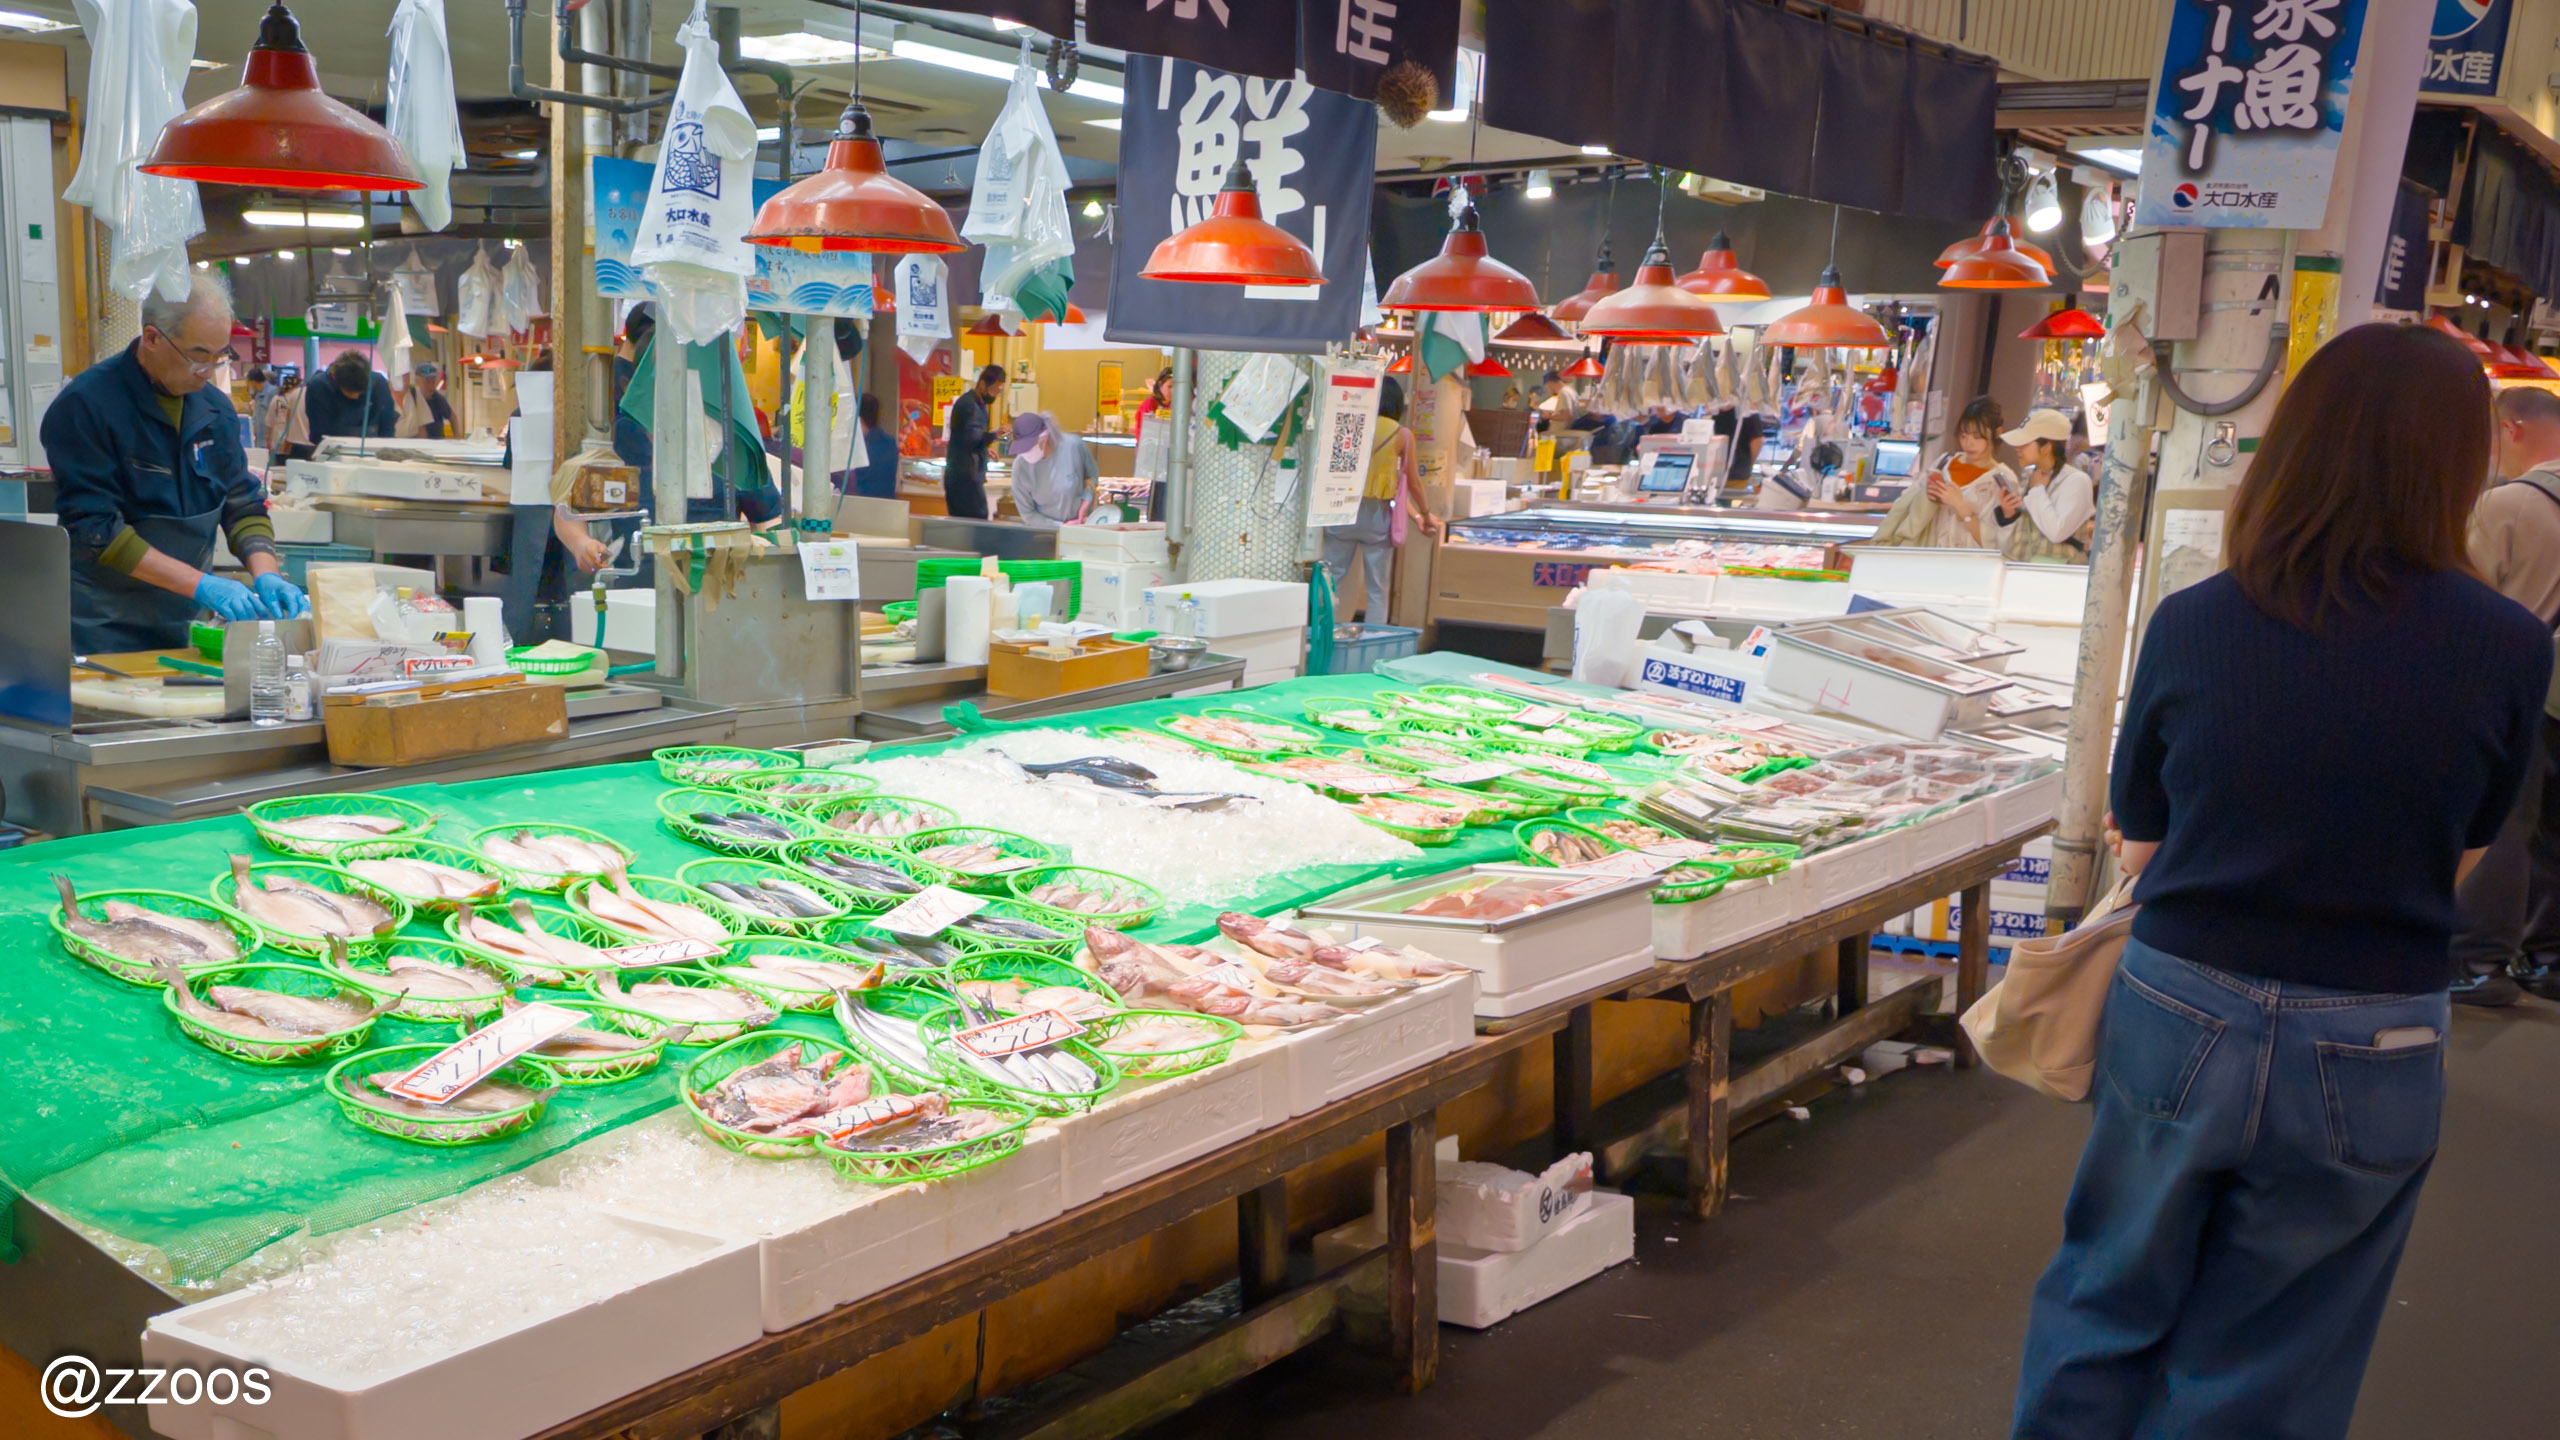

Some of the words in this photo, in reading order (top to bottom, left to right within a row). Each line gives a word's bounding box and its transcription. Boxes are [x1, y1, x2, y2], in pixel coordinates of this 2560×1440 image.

[2179, 0, 2245, 170] ーナー
[2202, 191, 2279, 209] 大口水産
[665, 207, 711, 228] 大口水産
